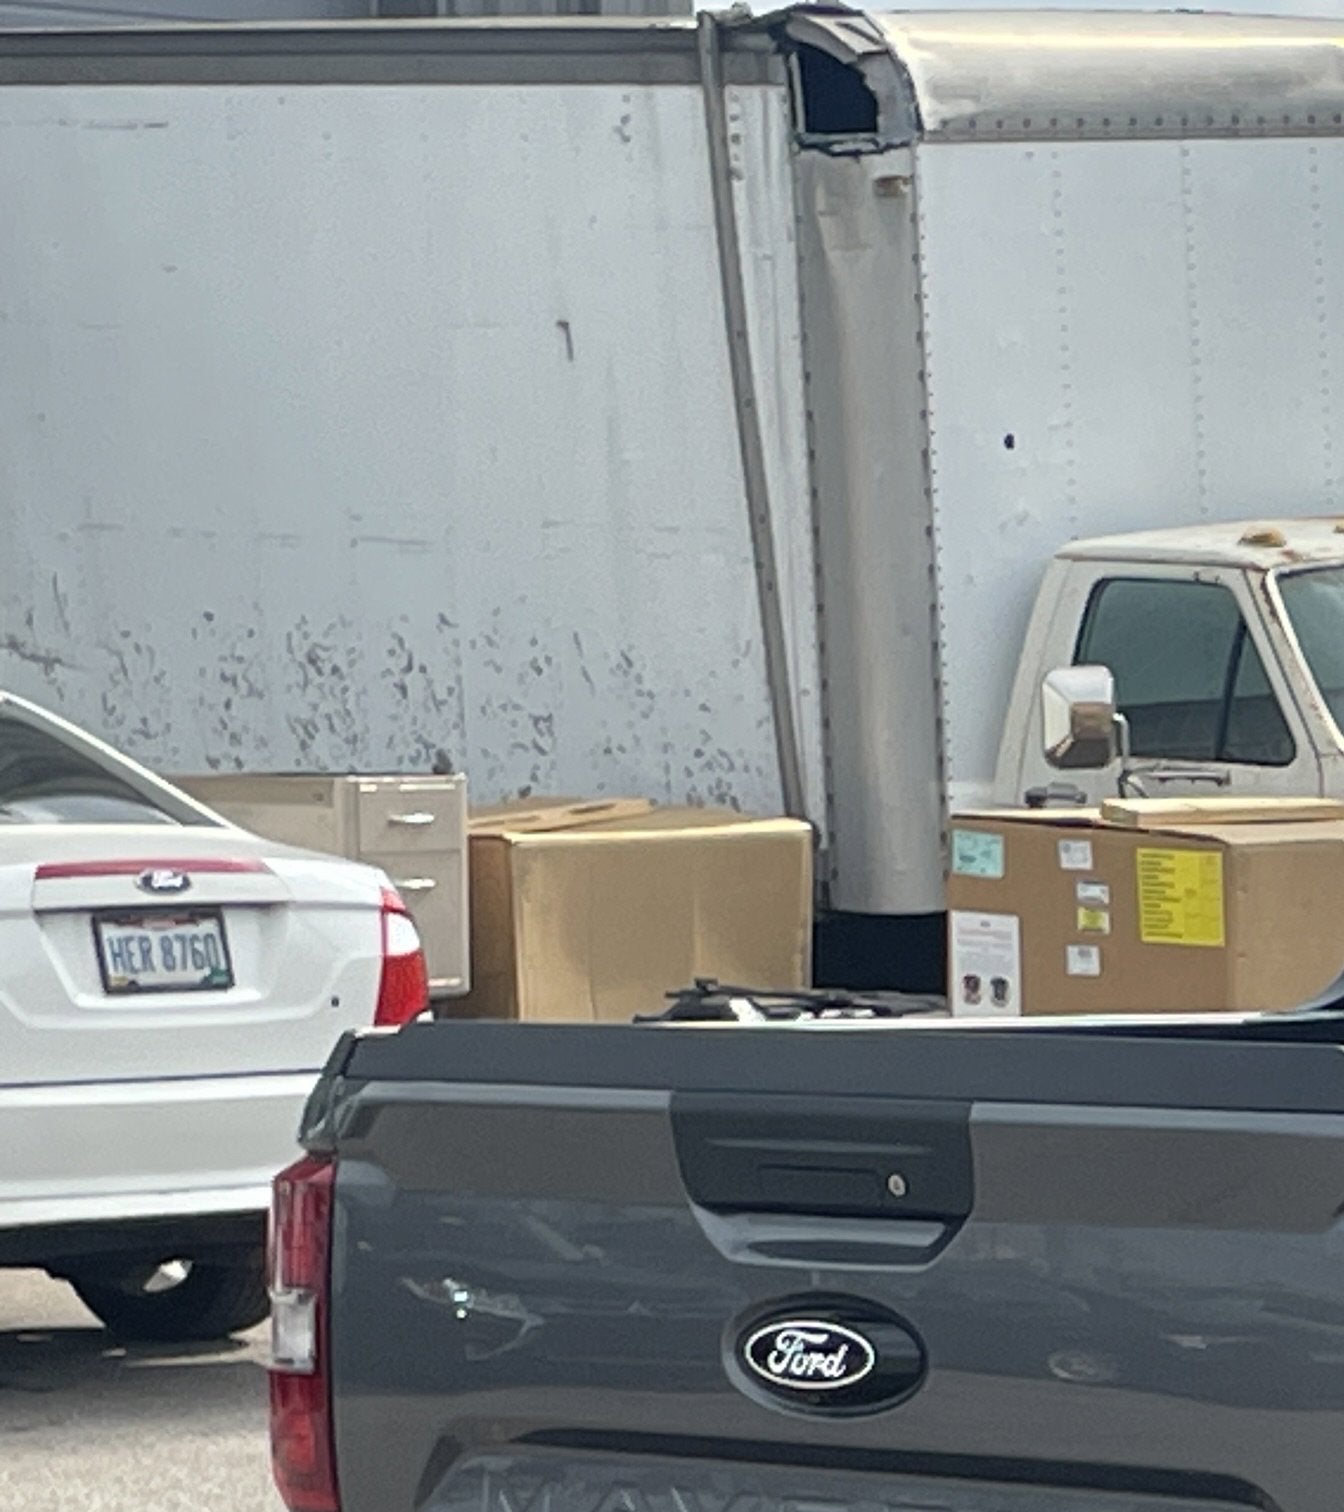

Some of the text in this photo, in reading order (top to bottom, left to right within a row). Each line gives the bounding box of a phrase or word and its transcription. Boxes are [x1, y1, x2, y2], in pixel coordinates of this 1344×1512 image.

[107, 933, 221, 975] HER 8760
[766, 1328, 849, 1379] Ford
